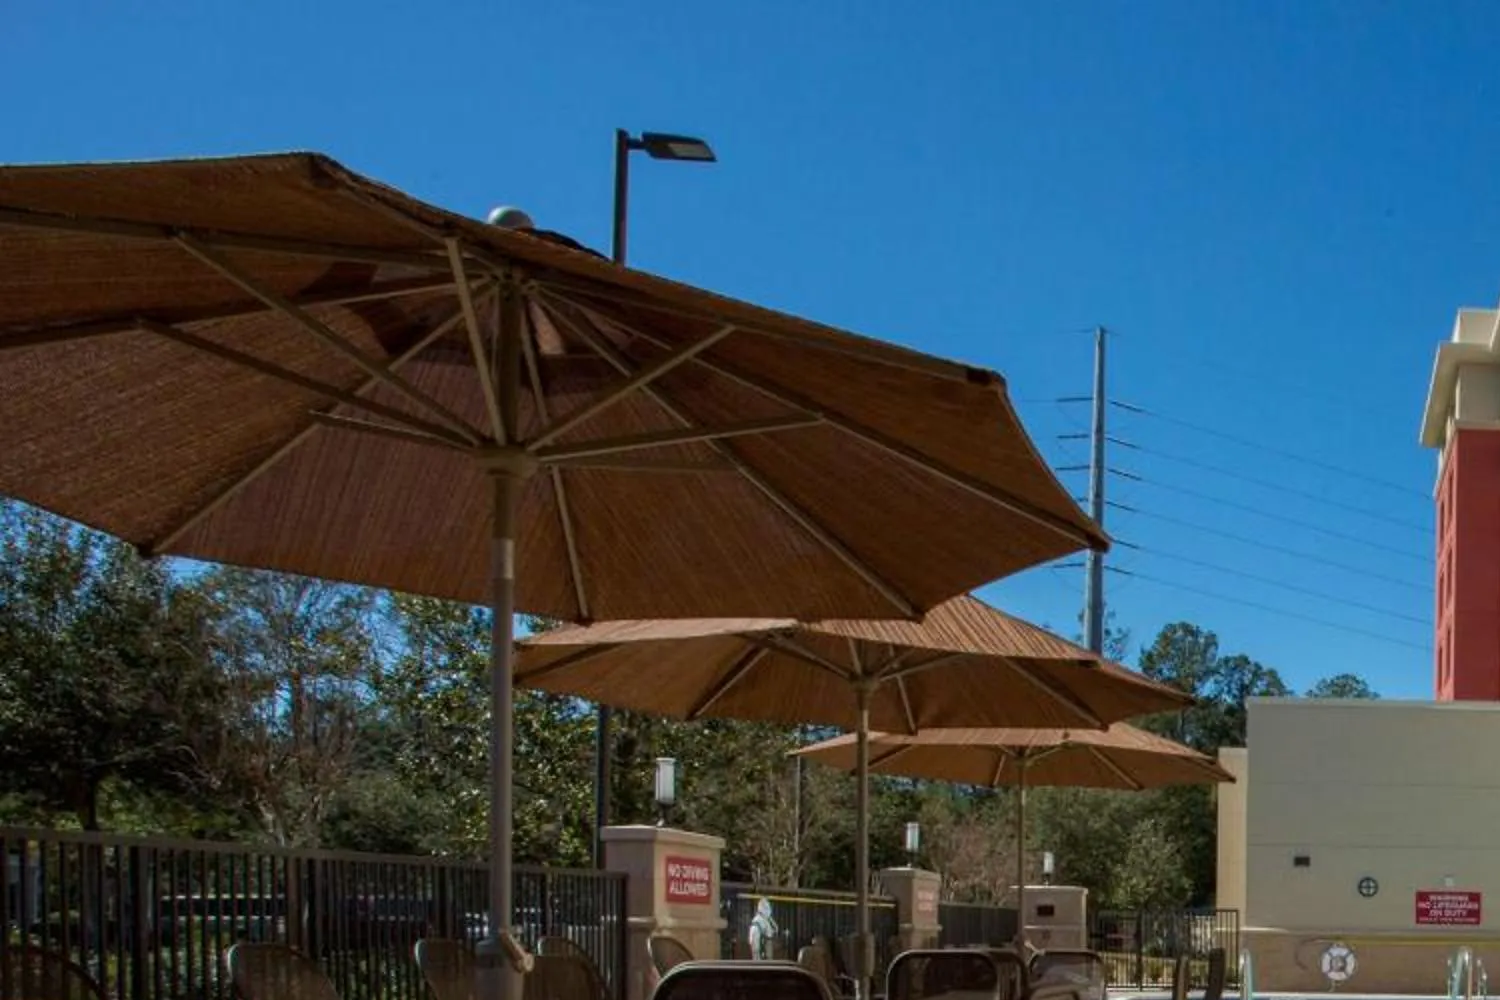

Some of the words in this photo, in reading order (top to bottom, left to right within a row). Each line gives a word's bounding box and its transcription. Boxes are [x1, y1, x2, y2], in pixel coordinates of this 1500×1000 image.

[668, 863, 680, 877] NO
[670, 880, 708, 896] ALLOWED
[1429, 909, 1443, 917] ON
[1444, 909, 1468, 917] DUTY
